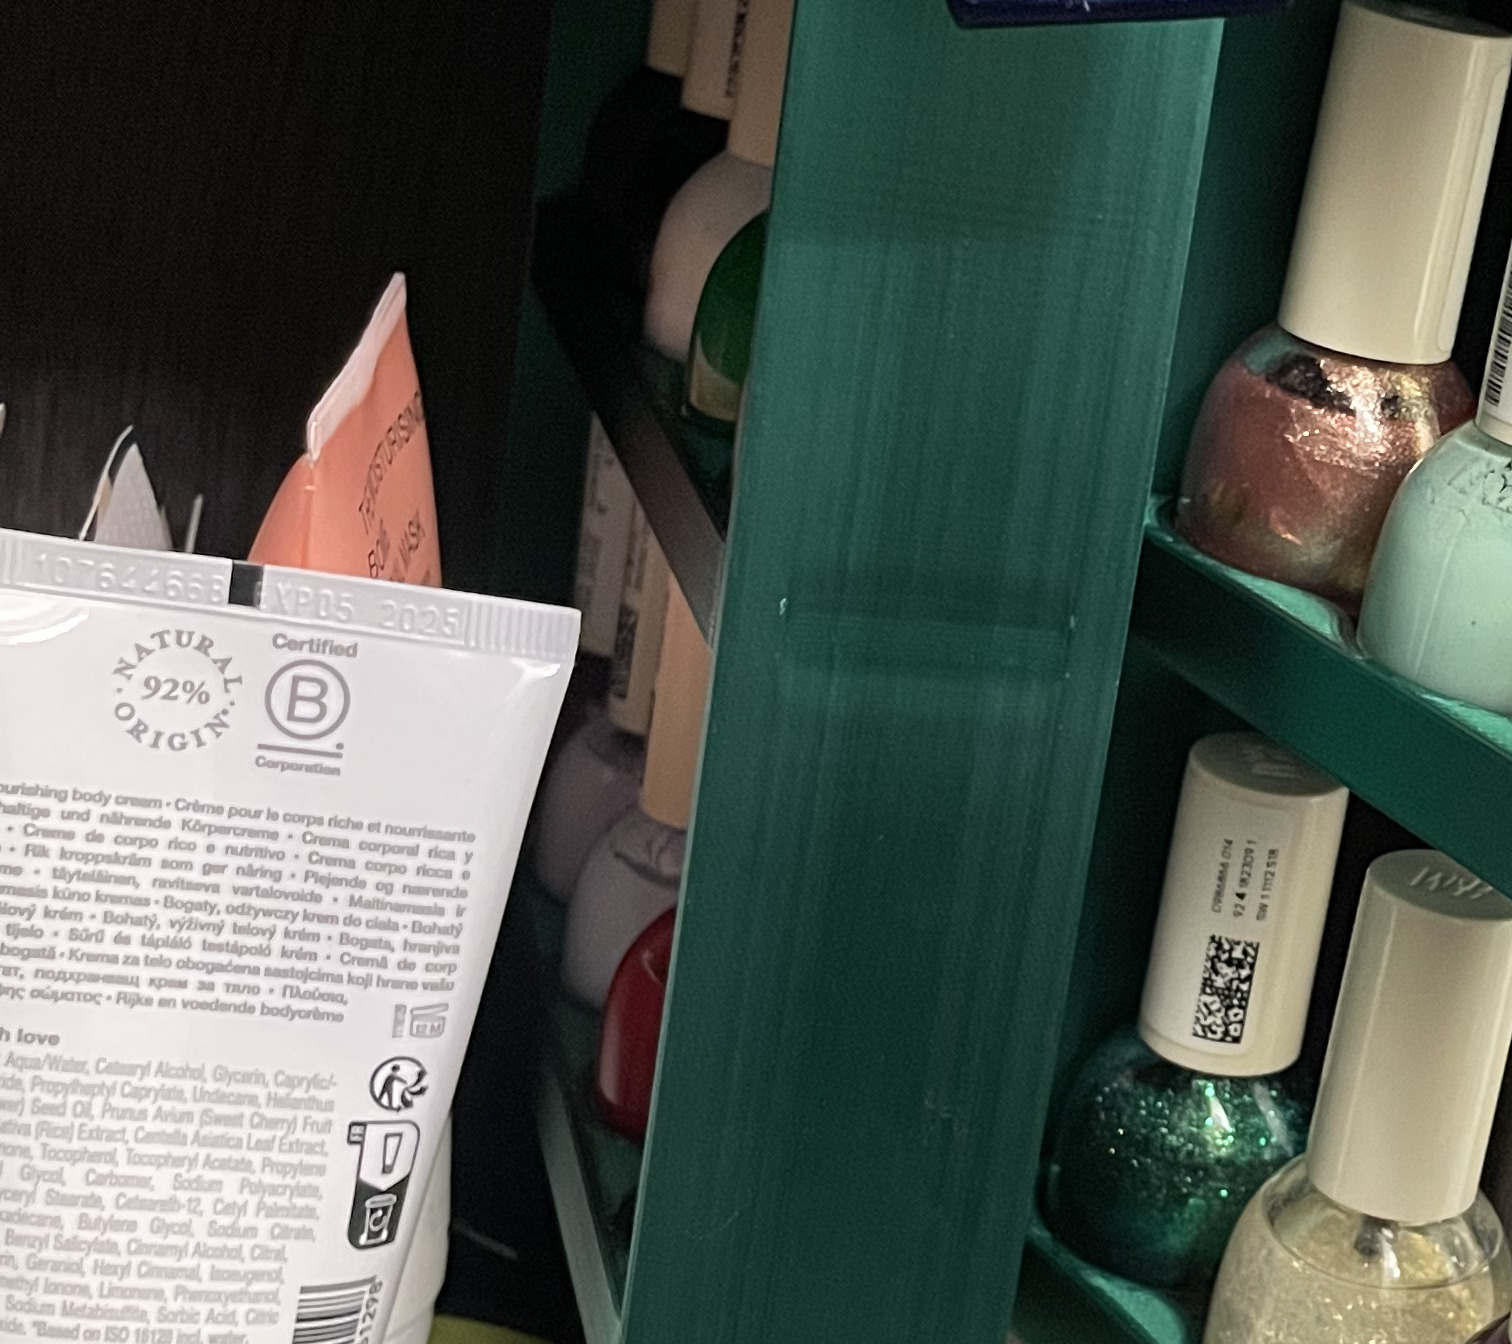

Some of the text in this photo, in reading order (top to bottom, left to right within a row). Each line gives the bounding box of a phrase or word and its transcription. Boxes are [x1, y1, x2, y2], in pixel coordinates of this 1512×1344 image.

[381, 598, 460, 637] 2025
[112, 628, 243, 693] NATURAL
[271, 632, 358, 658] Certified
[140, 674, 211, 705] 92%
[286, 673, 329, 725] B
[113, 700, 231, 752] ORIGIN
[254, 754, 341, 776] Corporation
[72, 788, 163, 809] body cream
[60, 808, 279, 841] und nährende Körpercreme
[174, 797, 477, 844] Crème pour le corps riche et nourrissante
[23, 823, 286, 862] Creme de corpo rico e nutritivo
[301, 830, 474, 866] Crema corporal rica y
[24, 843, 228, 876] Rik som ger
[307, 850, 471, 881] Crema corpo ricca e
[94, 889, 151, 907] kremas
[231, 882, 323, 904] vartalovoide
[303, 869, 394, 896] Plejende og
[163, 895, 362, 928] Bogaty, krem do
[67, 947, 120, 965] Krema
[121, 954, 140, 967] za
[144, 954, 173, 970] telo
[347, 970, 373, 990] koji
[375, 974, 419, 991] hrane
[397, 958, 458, 976] de corp
[115, 991, 155, 1010] Rijke
[158, 996, 177, 1009] en
[181, 998, 256, 1016] voedende
[16, 1028, 61, 1047] love
[154, 1059, 207, 1084] Alcohol,
[102, 1103, 149, 1122] Prunus
[152, 1105, 194, 1124] Avium
[302, 1115, 333, 1134] Fruit
[172, 1172, 223, 1193] Sodium
[82, 1326, 130, 1343] on ISO
